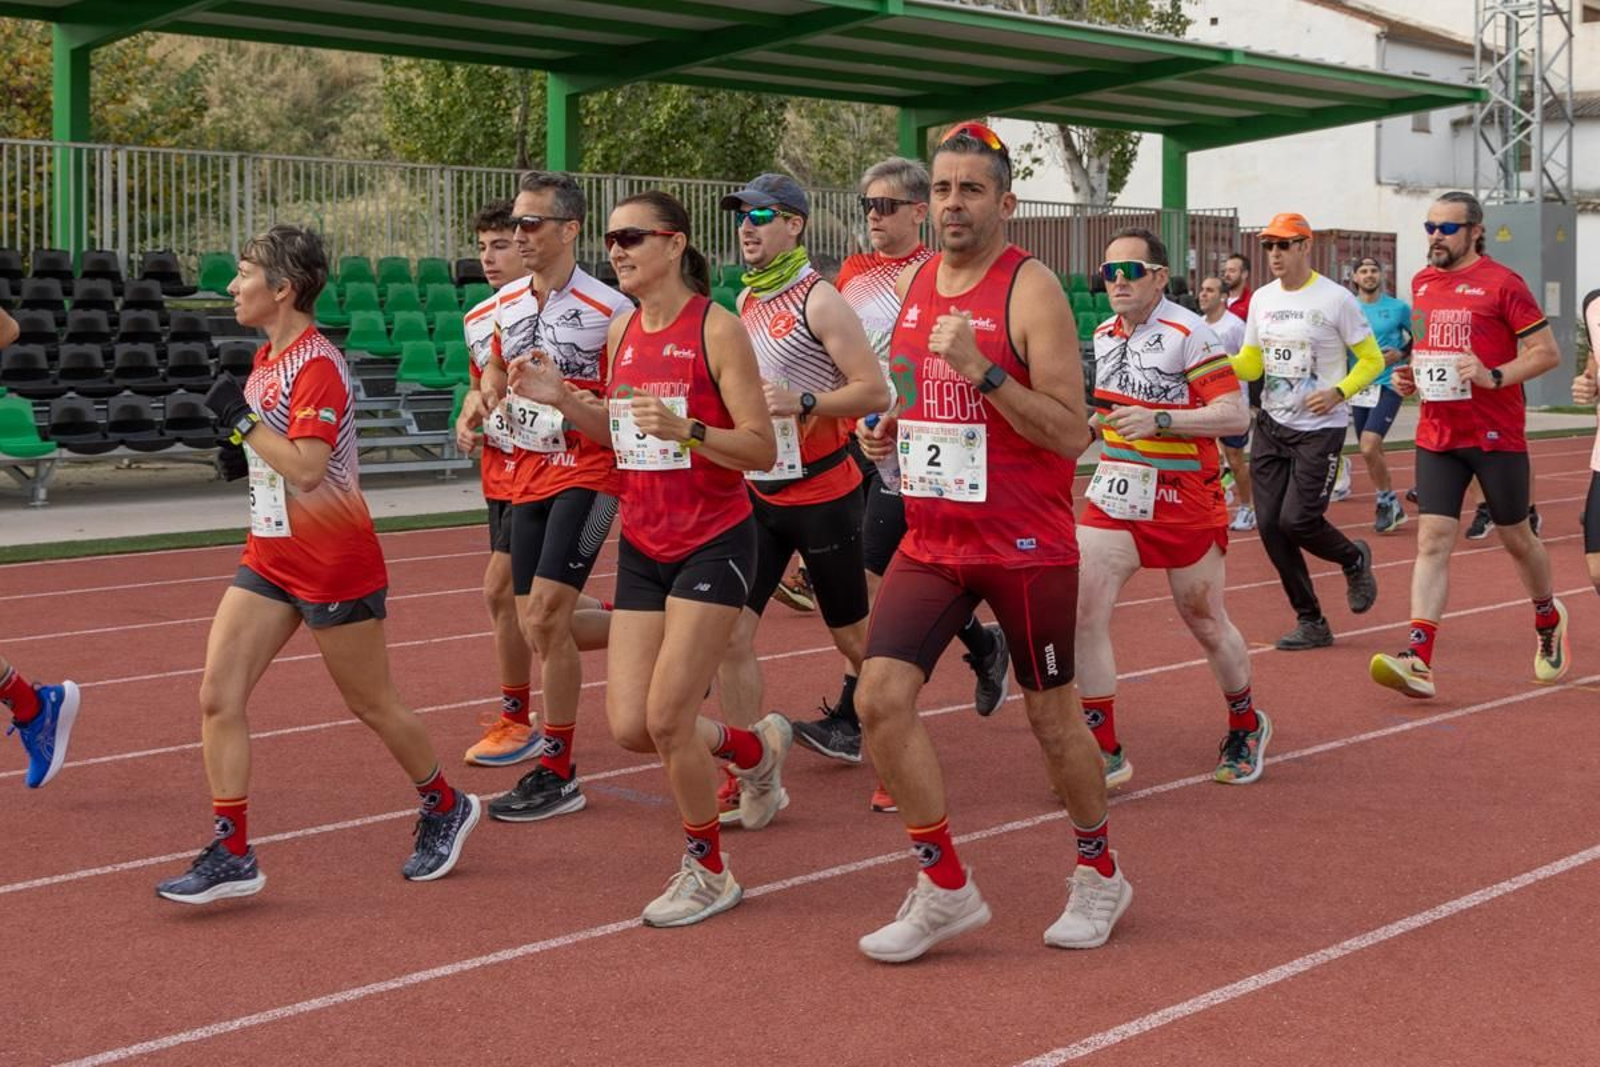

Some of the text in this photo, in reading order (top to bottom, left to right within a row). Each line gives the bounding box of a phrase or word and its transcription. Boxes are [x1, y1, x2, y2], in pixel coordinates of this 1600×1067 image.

[1429, 323, 1472, 349] ALBOR
[1274, 348, 1292, 361] 50
[1427, 368, 1447, 382] 12
[922, 379, 988, 421] ALBOR
[517, 407, 539, 428] 37
[926, 443, 942, 467] 2
[1107, 477, 1129, 496] 10
